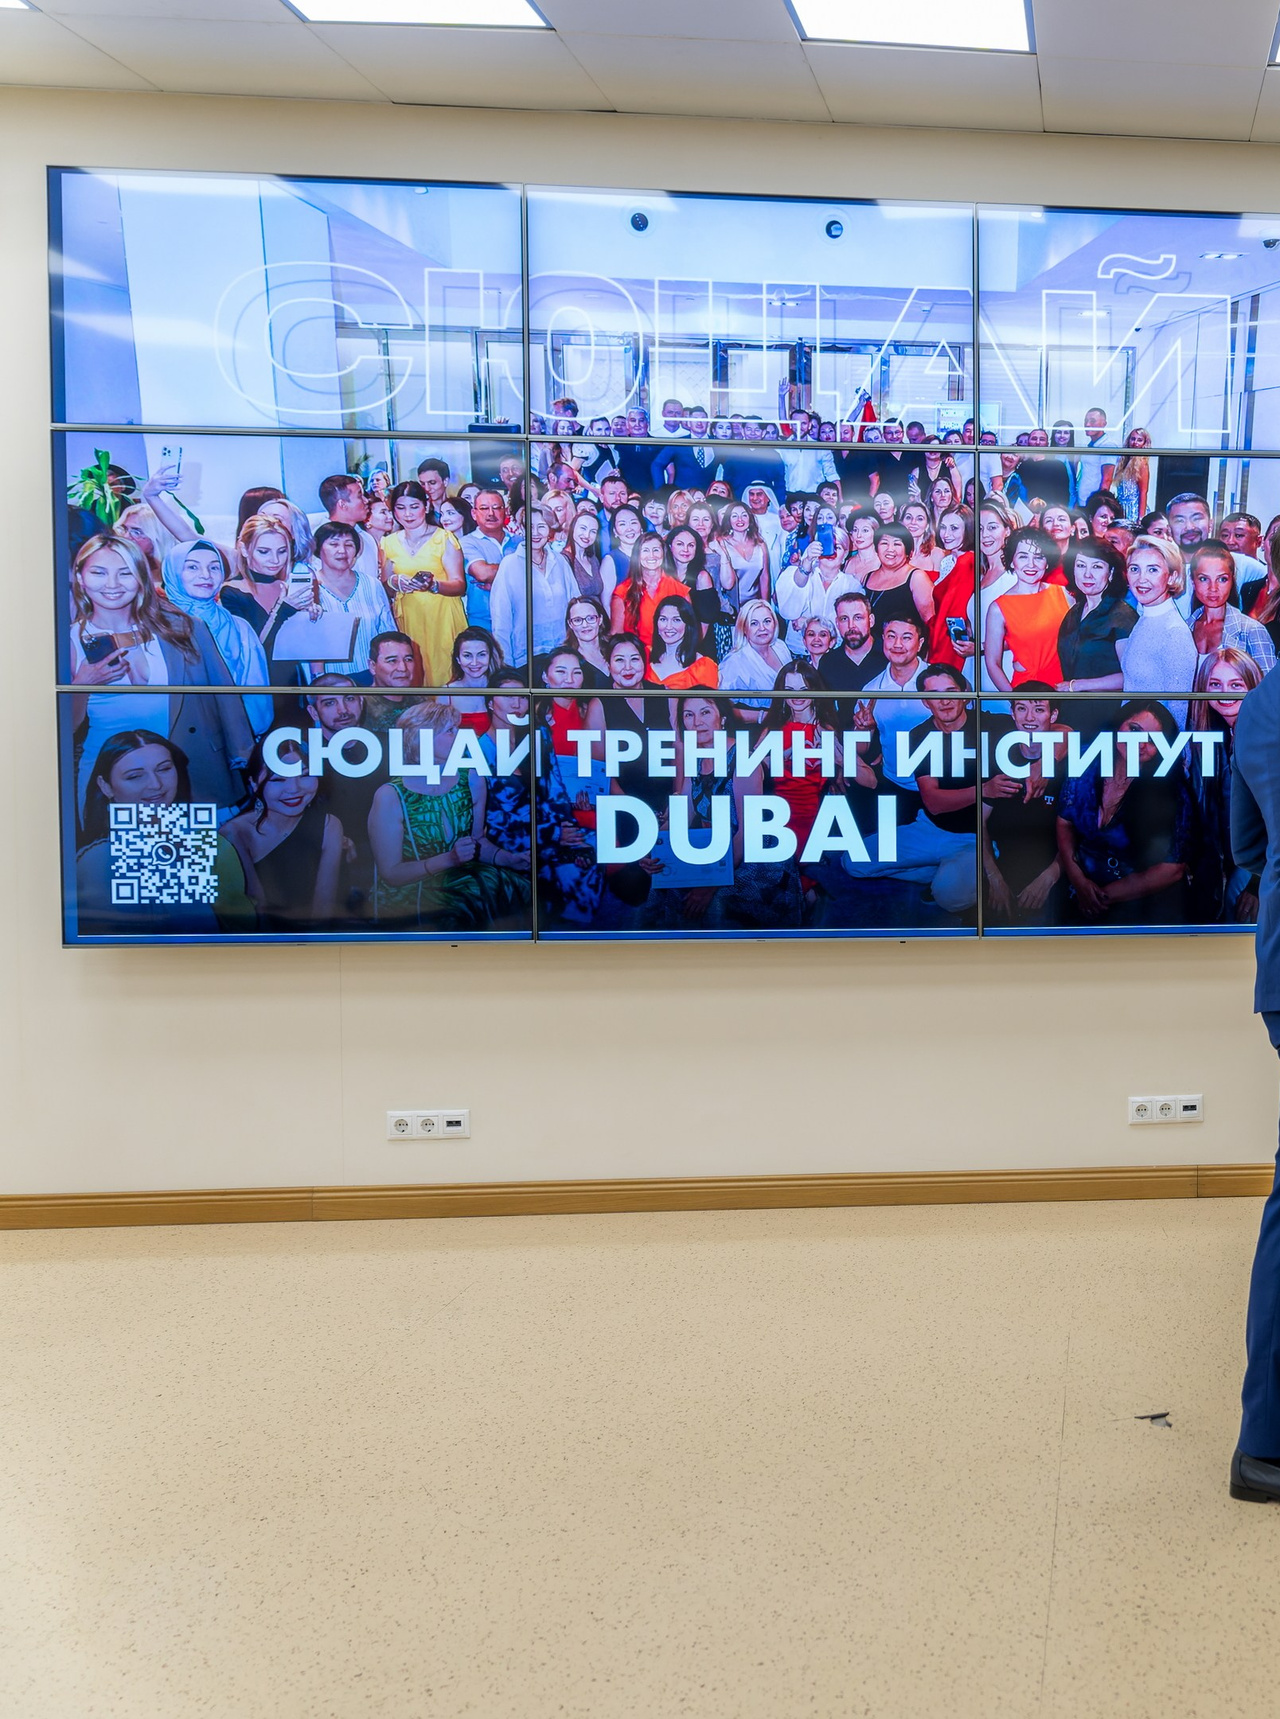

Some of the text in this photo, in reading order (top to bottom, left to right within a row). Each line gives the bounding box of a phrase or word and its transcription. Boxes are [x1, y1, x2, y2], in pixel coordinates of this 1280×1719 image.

[213, 252, 1232, 441] СЮЦАЙ
[261, 713, 1224, 785] СЮЦАЙ ТРЕНИНГ ИНСТИТУТ
[596, 794, 898, 865] DUBAI
